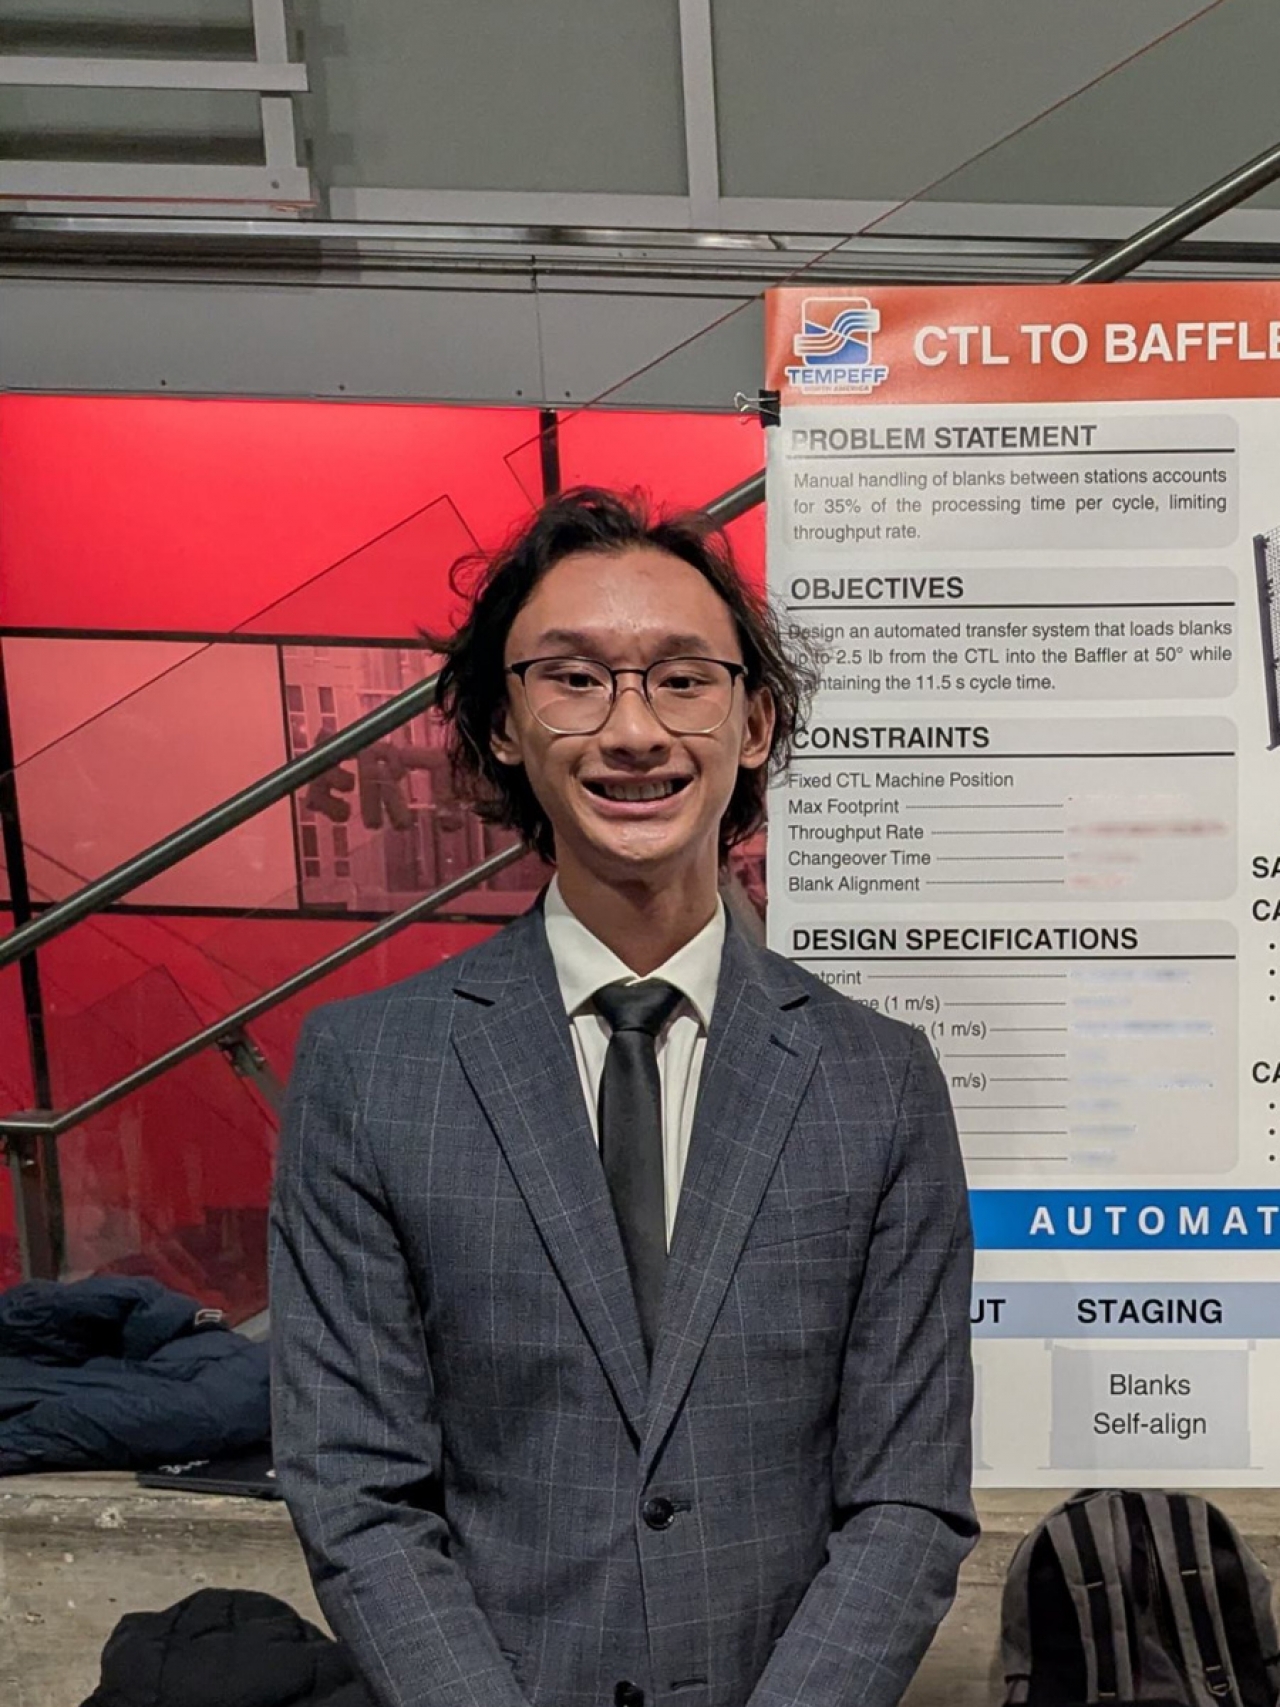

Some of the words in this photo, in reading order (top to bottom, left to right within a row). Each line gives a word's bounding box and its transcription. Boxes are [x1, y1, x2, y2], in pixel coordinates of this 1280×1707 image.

[913, 325, 1009, 365] CTL
[1021, 324, 1087, 364] TO
[787, 368, 887, 384] TEMPEFF
[793, 428, 925, 450] PROBLEM
[935, 425, 1097, 448] STATEMENT
[795, 472, 853, 488] Manual
[859, 472, 927, 490] handling
[933, 471, 947, 486] of
[953, 471, 1005, 485] blanks
[1011, 471, 1079, 485] between
[1085, 468, 1147, 484] stations
[1153, 468, 1226, 483] accounts
[794, 499, 815, 514] for
[825, 499, 861, 513] 35%
[871, 498, 886, 512] of
[896, 498, 921, 512] the
[932, 496, 1020, 515] processing
[1031, 496, 1065, 510] time
[1076, 498, 1102, 514] per
[1112, 495, 1158, 513] cycle,
[1170, 494, 1226, 512] limiting
[794, 524, 880, 543] throughput
[886, 525, 920, 538] rate.
[792, 576, 963, 599] OBJECTIVES
[788, 624, 844, 642] Design
[849, 627, 869, 638] an
[874, 623, 960, 638] automated
[966, 623, 1027, 637] transfer
[1032, 623, 1089, 641] system
[1095, 622, 1125, 636] that
[1131, 621, 1174, 636] loads
[1179, 620, 1232, 635] blanks
[792, 726, 990, 749] CONSTRAINTS
[787, 769, 831, 788] Fixed
[836, 772, 871, 788] CTL
[876, 773, 944, 787] Machine
[950, 772, 1013, 787] Position
[789, 799, 822, 814] Max
[828, 798, 899, 817] Footprint
[788, 825, 881, 843] Throughput
[886, 825, 923, 839] Rate
[788, 851, 887, 869] Changeover
[890, 850, 930, 865] Time
[789, 876, 833, 891] Blank
[838, 876, 919, 895] Alignment
[794, 929, 896, 950] DESIGN
[906, 928, 1138, 950] SPECIFICATIONS
[1078, 1299, 1222, 1323] STAGING
[1111, 1374, 1190, 1395] Blanks
[1094, 1412, 1206, 1440] Self-align
